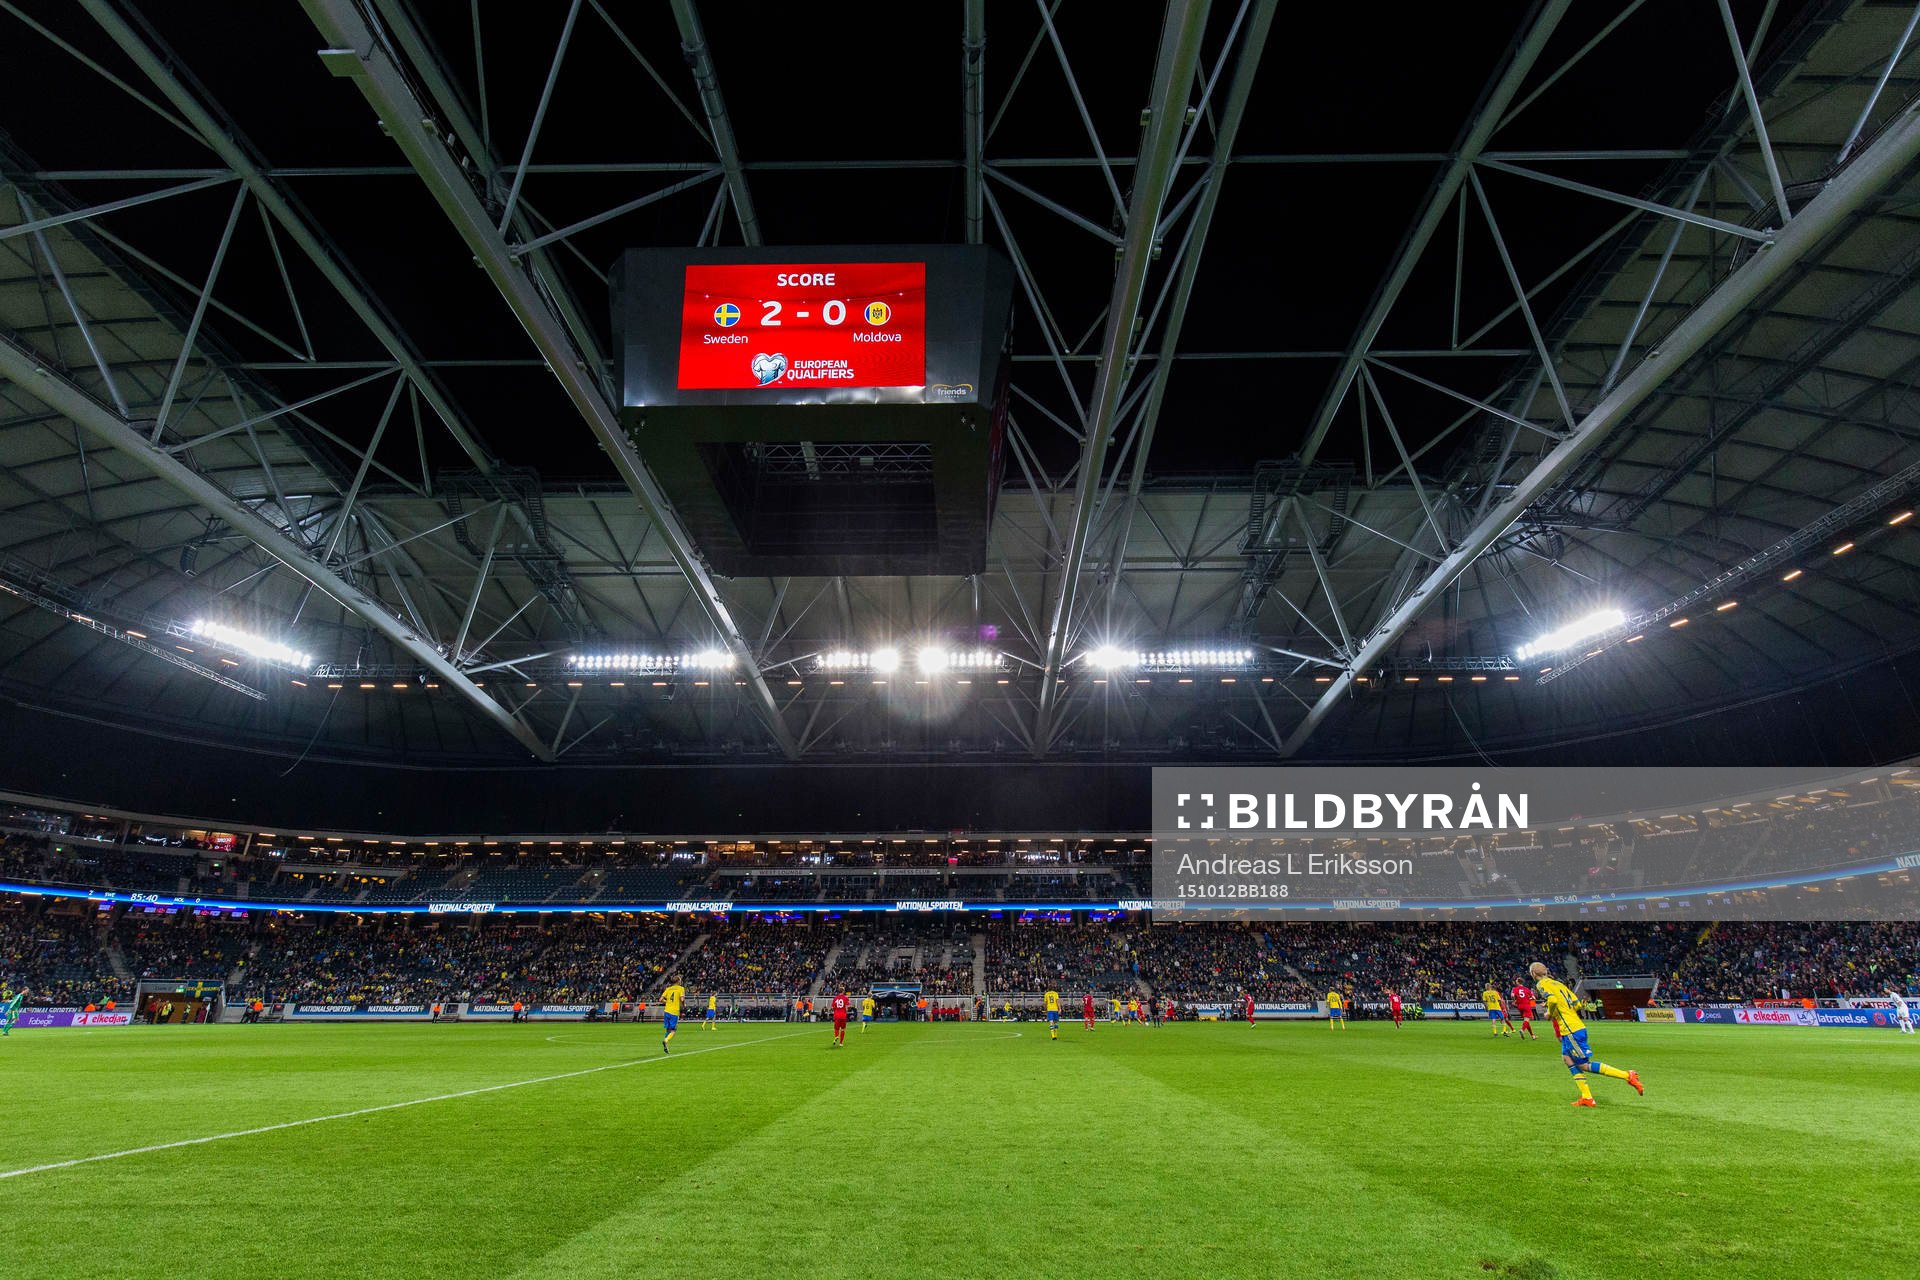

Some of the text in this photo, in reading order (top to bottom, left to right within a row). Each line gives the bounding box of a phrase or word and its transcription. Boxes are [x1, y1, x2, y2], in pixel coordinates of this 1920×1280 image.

[776, 273, 836, 287] SCORE
[760, 301, 782, 327] 2
[822, 300, 847, 326] 0
[703, 333, 749, 345] Sweden
[853, 331, 902, 343] Moldova
[794, 360, 848, 370] EUROPEAN
[787, 369, 855, 381] QUALIFIERS
[937, 385, 967, 396] friends
[130, 893, 158, 903] 85:40
[1554, 894, 1578, 904] 85:40
[428, 903, 495, 912] NATIONALSPORTEN
[666, 902, 733, 912] NATIONALSPORTEN
[896, 901, 963, 911] NATIONALSPORTEN
[1118, 900, 1185, 910] NATIONALSPORTEN
[1333, 899, 1400, 909] NATIONALSPORTEN
[669, 991, 676, 1003] 4
[1518, 989, 1525, 998] 5
[835, 998, 844, 1009] 19
[300, 1005, 351, 1013] NATIONALSPORTEN
[367, 1005, 419, 1013] NATIONALSPORTEN
[28, 1017, 53, 1026] Fabege
[92, 1014, 128, 1024] elkedjan
[1753, 1010, 1791, 1023] elkedjan
[1817, 1012, 1869, 1025] latravel.se
